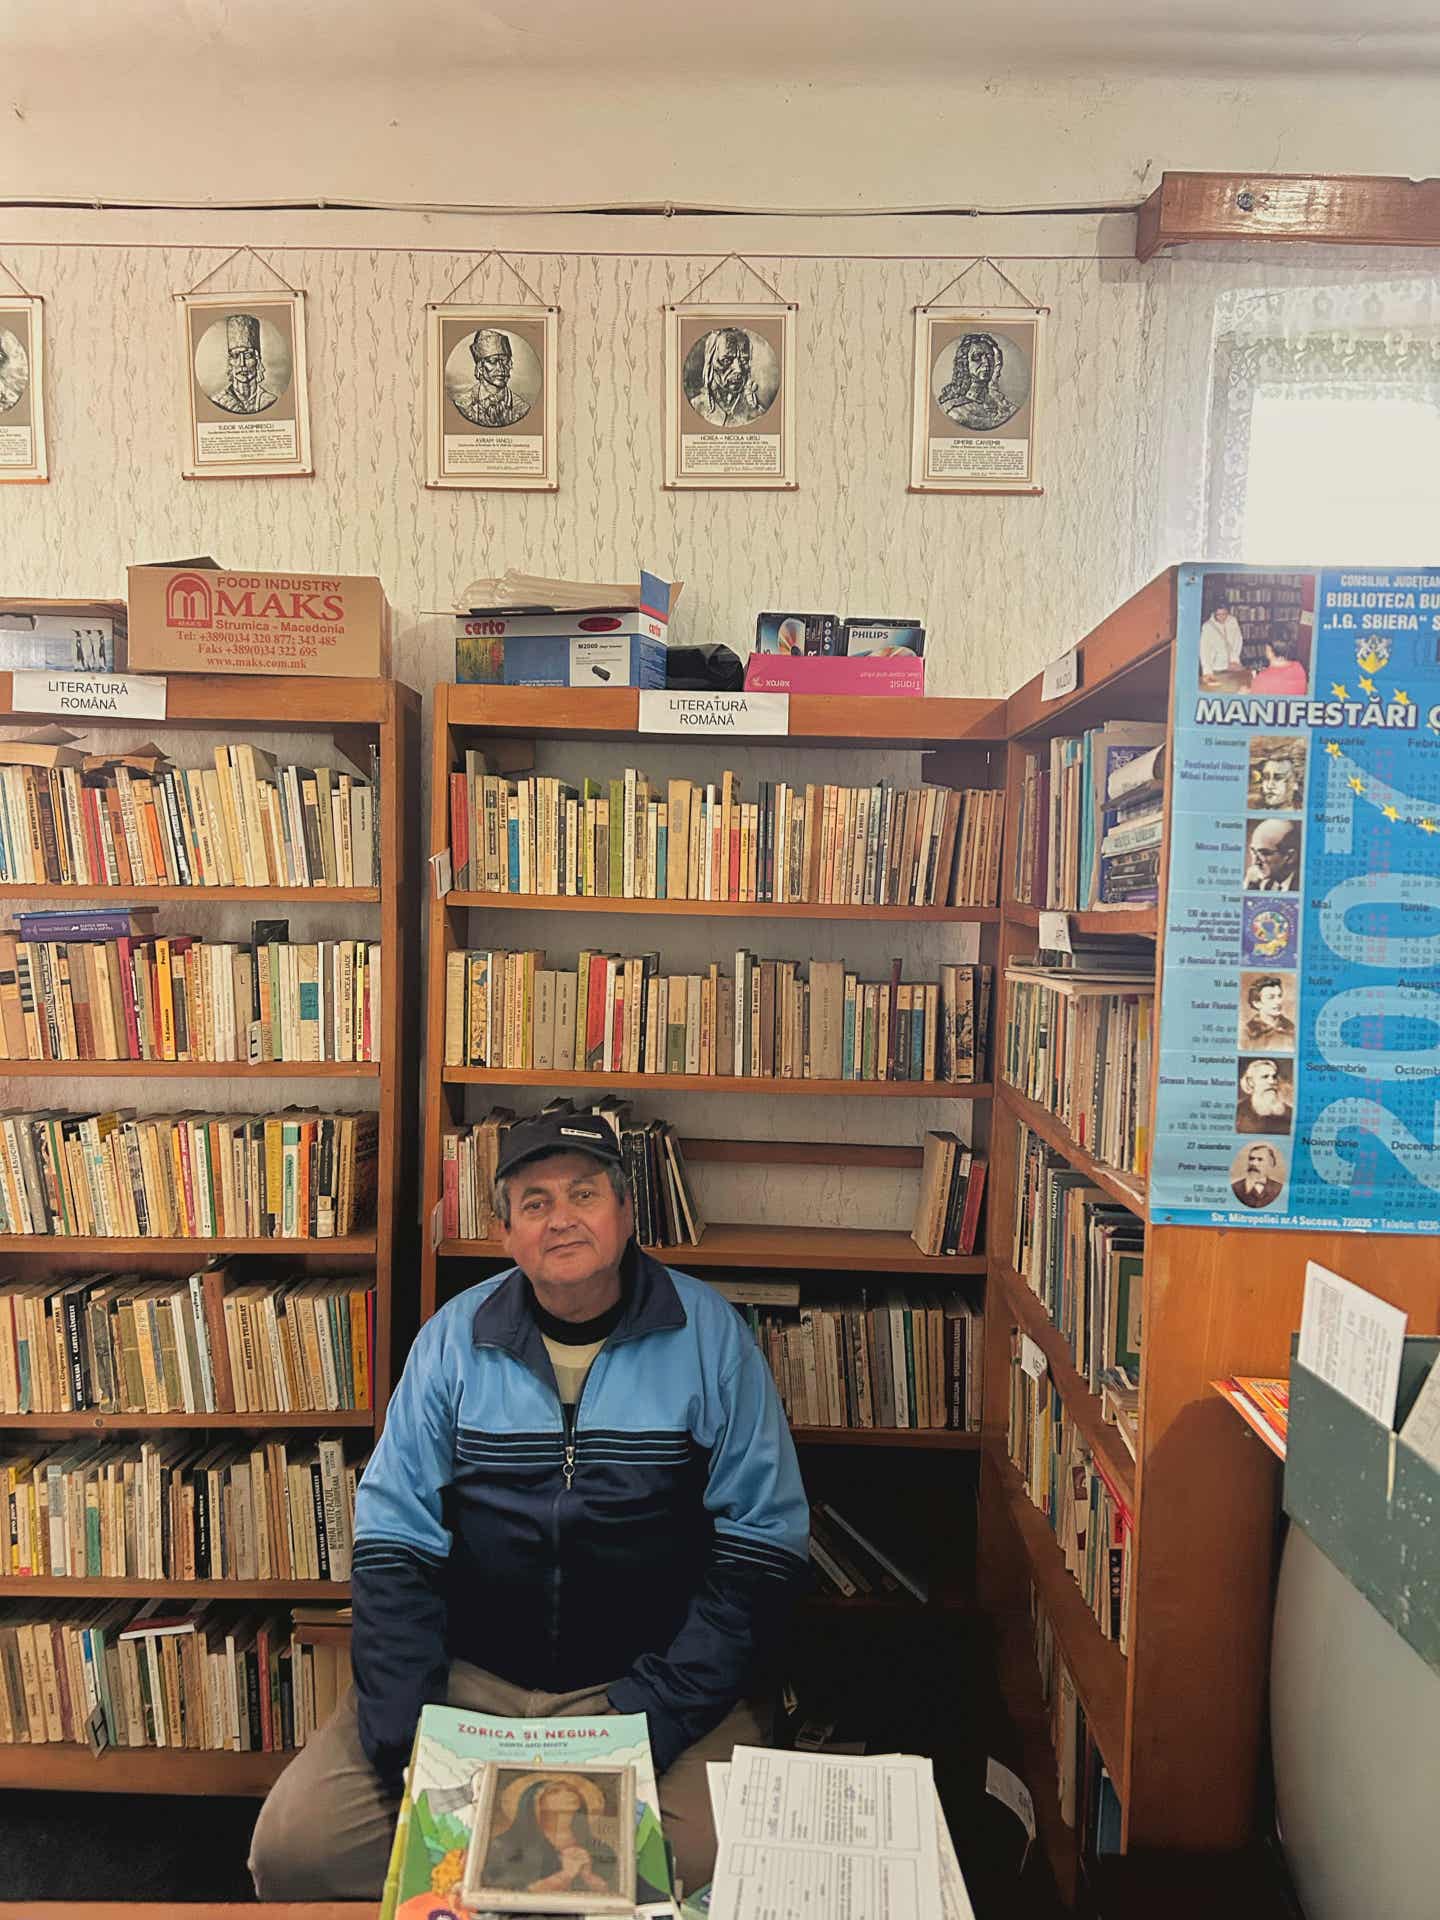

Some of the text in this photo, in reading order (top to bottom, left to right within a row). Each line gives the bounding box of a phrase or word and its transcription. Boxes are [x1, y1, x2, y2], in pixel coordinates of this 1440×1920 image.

[218, 577, 341, 592] FOOD INDUSTRY
[1341, 575, 1390, 588] CONSILIUL
[214, 591, 344, 621] MAKS
[1326, 593, 1415, 608] BIBLIOTECA
[216, 620, 269, 631] Strumica
[281, 622, 344, 634] Macedonia
[464, 620, 505, 635] certo
[177, 631, 195, 640] Tel:
[253, 633, 270, 644] 320
[851, 631, 888, 640] PHILIPS
[198, 643, 222, 653] Faks
[278, 647, 296, 656] 322
[300, 648, 318, 656] 695
[207, 657, 306, 668] www.maks.com.mk
[48, 681, 129, 695] LITERATURĂ
[890, 680, 920, 689] Transit
[60, 696, 117, 710] ROMÂNĂ
[669, 698, 749, 713] LITERATURĂ
[1195, 696, 1418, 727] MANIFESTĂRI
[679, 712, 735, 728] ROMÂNĂ
[1315, 814, 1350, 824] Martie
[1311, 900, 1332, 909] Mai
[1306, 1063, 1367, 1074] Septembrie
[1302, 1137, 1359, 1149] Noiembrie
[325, 1488, 335, 1524] VITEAZUL
[458, 1723, 515, 1739] ZORICA
[545, 1728, 609, 1739] NEGURA
